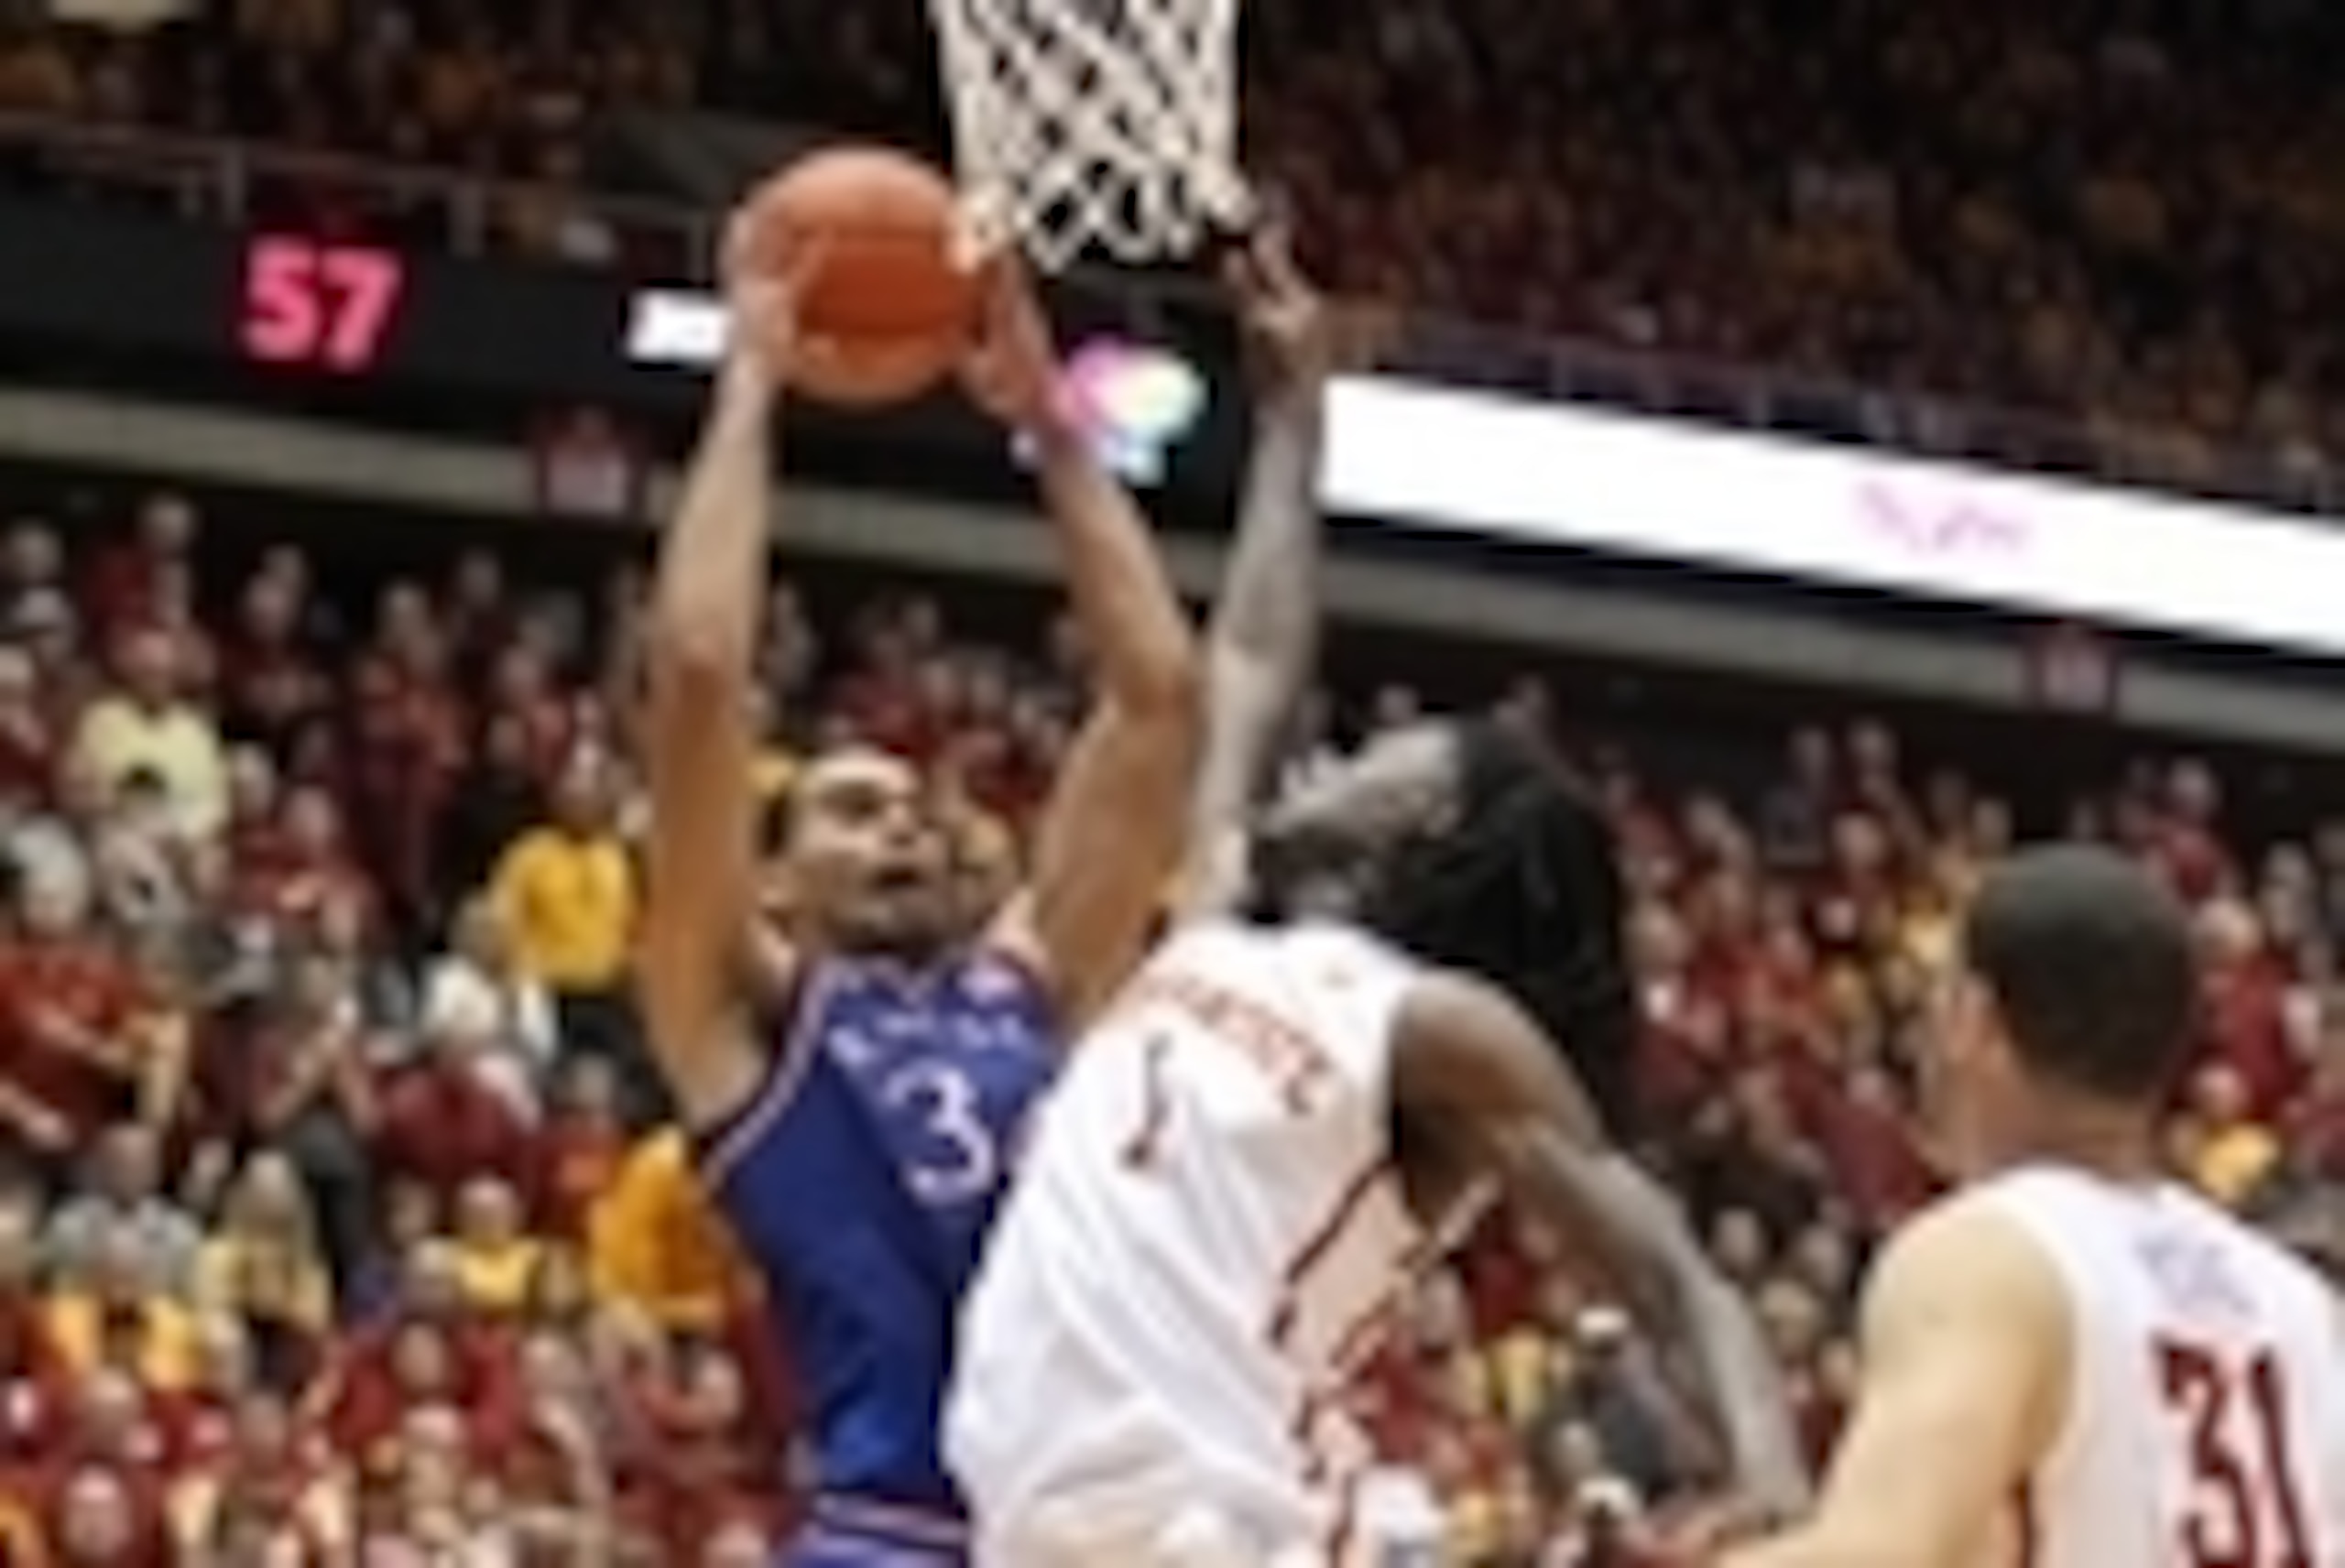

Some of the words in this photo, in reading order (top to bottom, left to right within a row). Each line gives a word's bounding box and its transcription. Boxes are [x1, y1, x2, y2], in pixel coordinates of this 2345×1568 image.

[243, 237, 401, 366] 57
[885, 1061, 993, 1205] 3
[2150, 1330, 2315, 1568] 31
